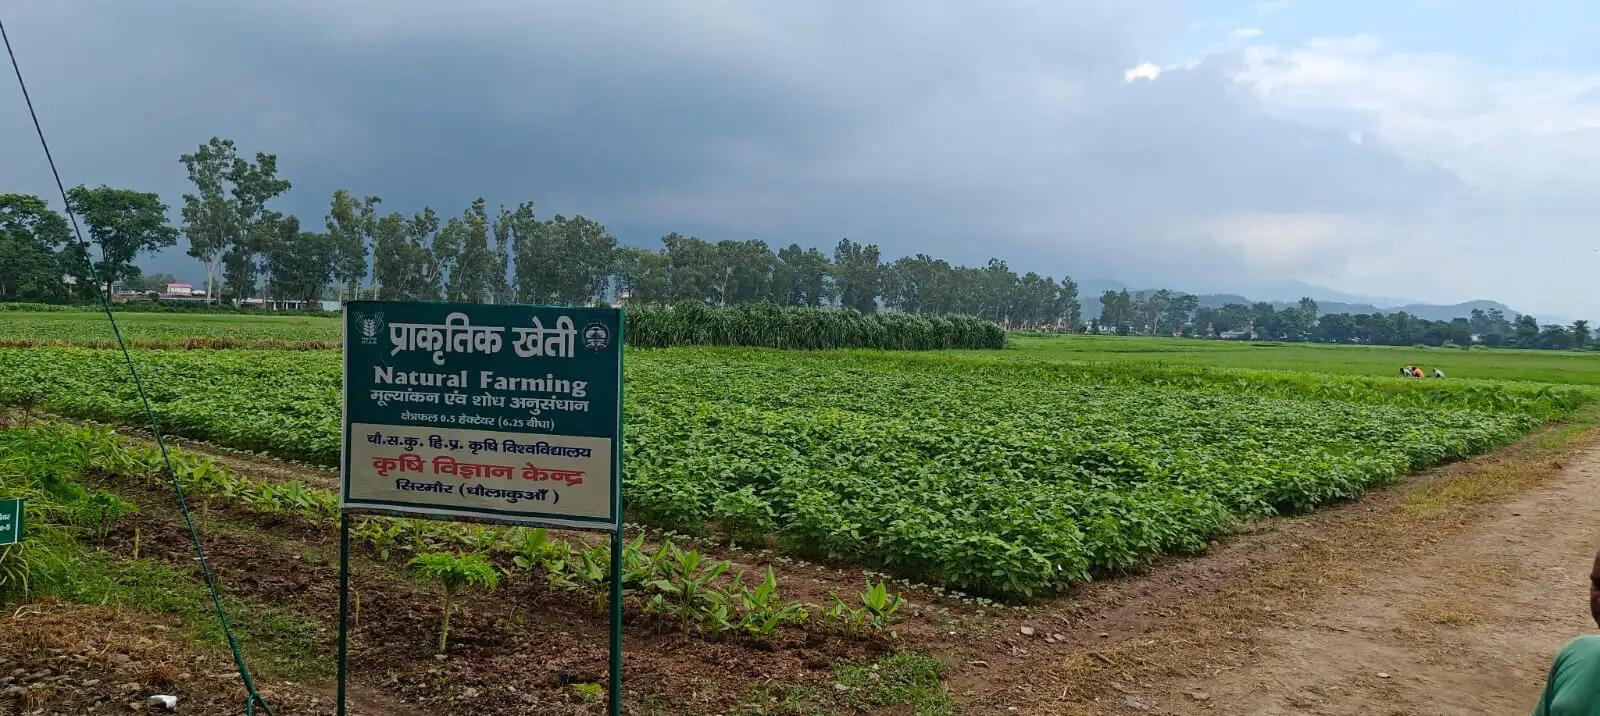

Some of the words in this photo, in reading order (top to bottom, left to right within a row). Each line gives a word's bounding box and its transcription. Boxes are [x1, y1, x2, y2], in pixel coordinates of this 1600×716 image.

[388, 312, 505, 366] प्राकृतिक
[511, 316, 578, 358] खेती
[374, 366, 468, 388] Natural
[480, 371, 588, 398] Farming
[370, 388, 440, 406] मूल्यांकन
[472, 391, 506, 408] शोध
[509, 395, 590, 415] अनुसंधान
[401, 410, 438, 423] क्षेत्रफल
[440, 415, 456, 423] 0.5
[498, 416, 524, 430] (6.25
[468, 438, 498, 455] कृषि
[502, 440, 592, 458] विश्वविद्यालय
[372, 453, 426, 477] कृषि
[432, 455, 515, 480] विज्ञान
[521, 461, 586, 487] केन्द्र
[396, 478, 454, 494] सिरमौर
